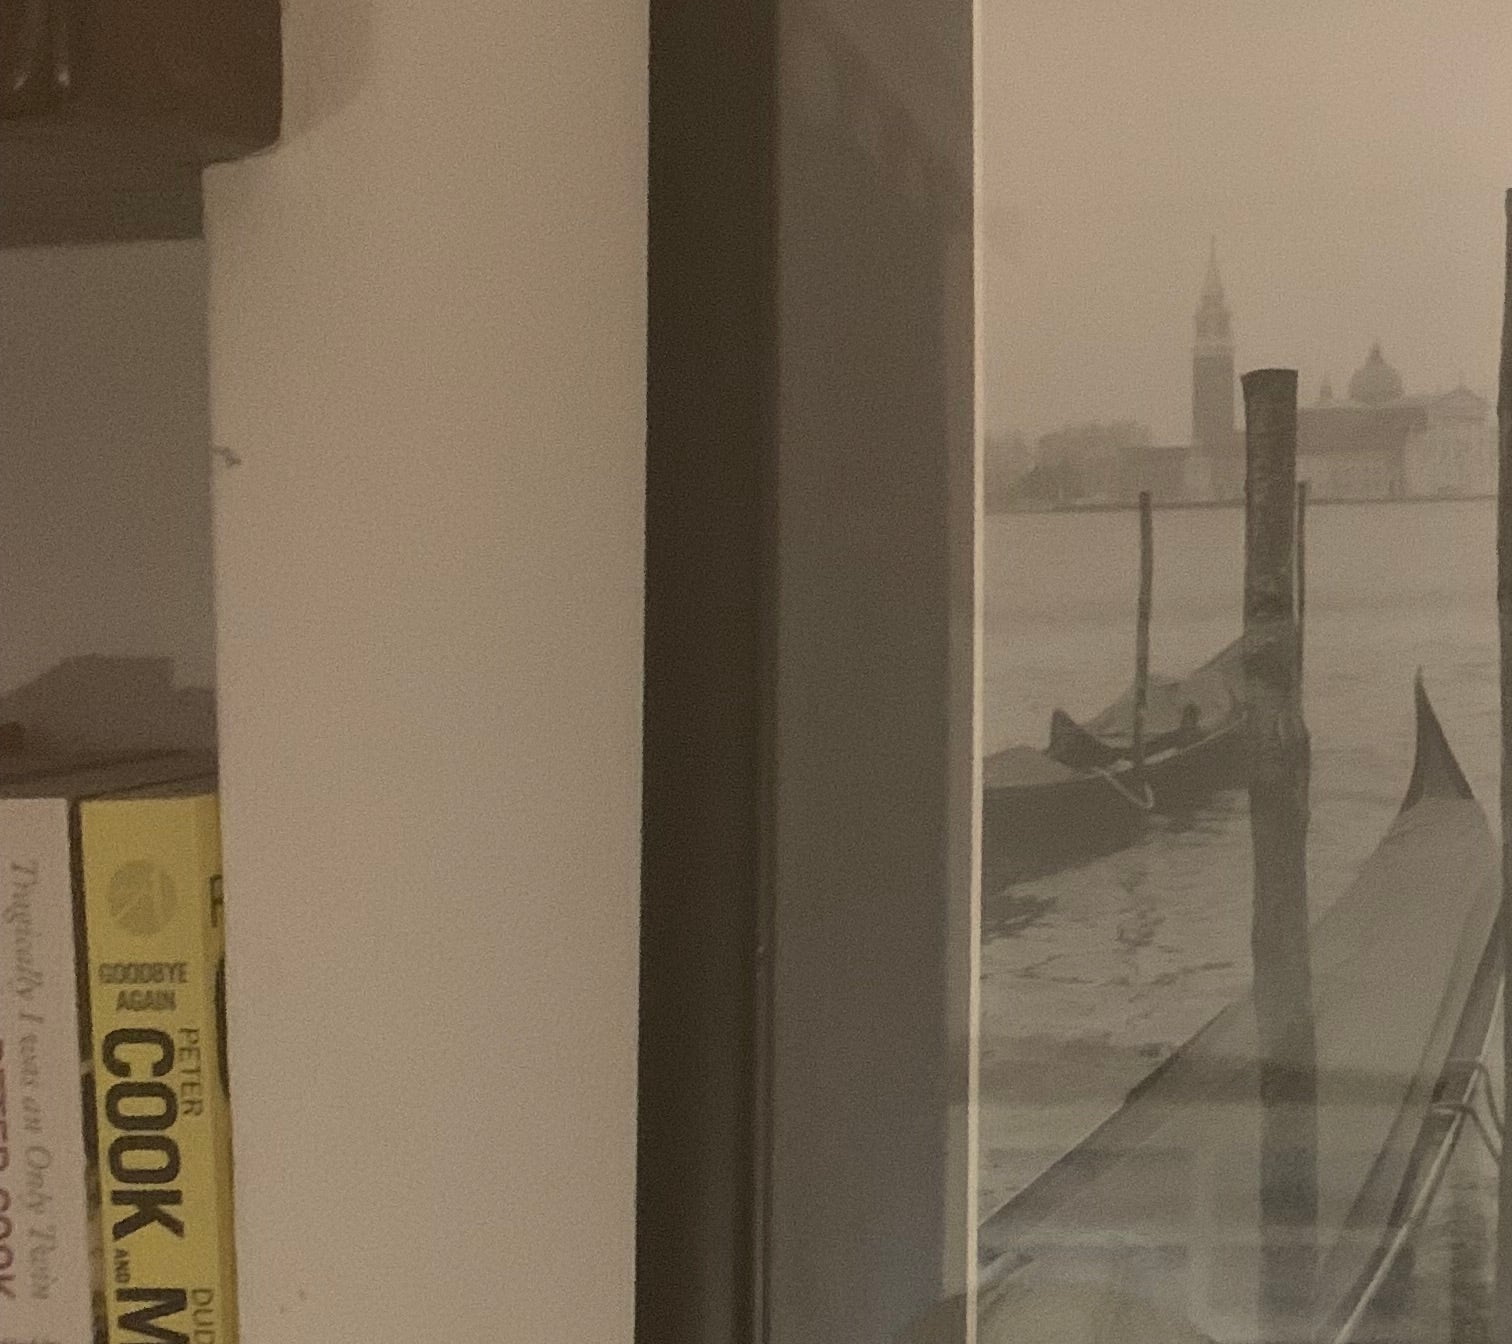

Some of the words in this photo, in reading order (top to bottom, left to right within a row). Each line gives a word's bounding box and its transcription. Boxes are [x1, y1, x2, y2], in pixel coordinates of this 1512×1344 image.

[98, 961, 188, 984] GOODBYE
[116, 989, 176, 1011] AGAIN
[178, 1027, 204, 1116] PETER
[102, 1027, 185, 1242] COOK
[24, 1145, 53, 1215] Only
[28, 1224, 58, 1299] Twin
[114, 1248, 132, 1284] AND
